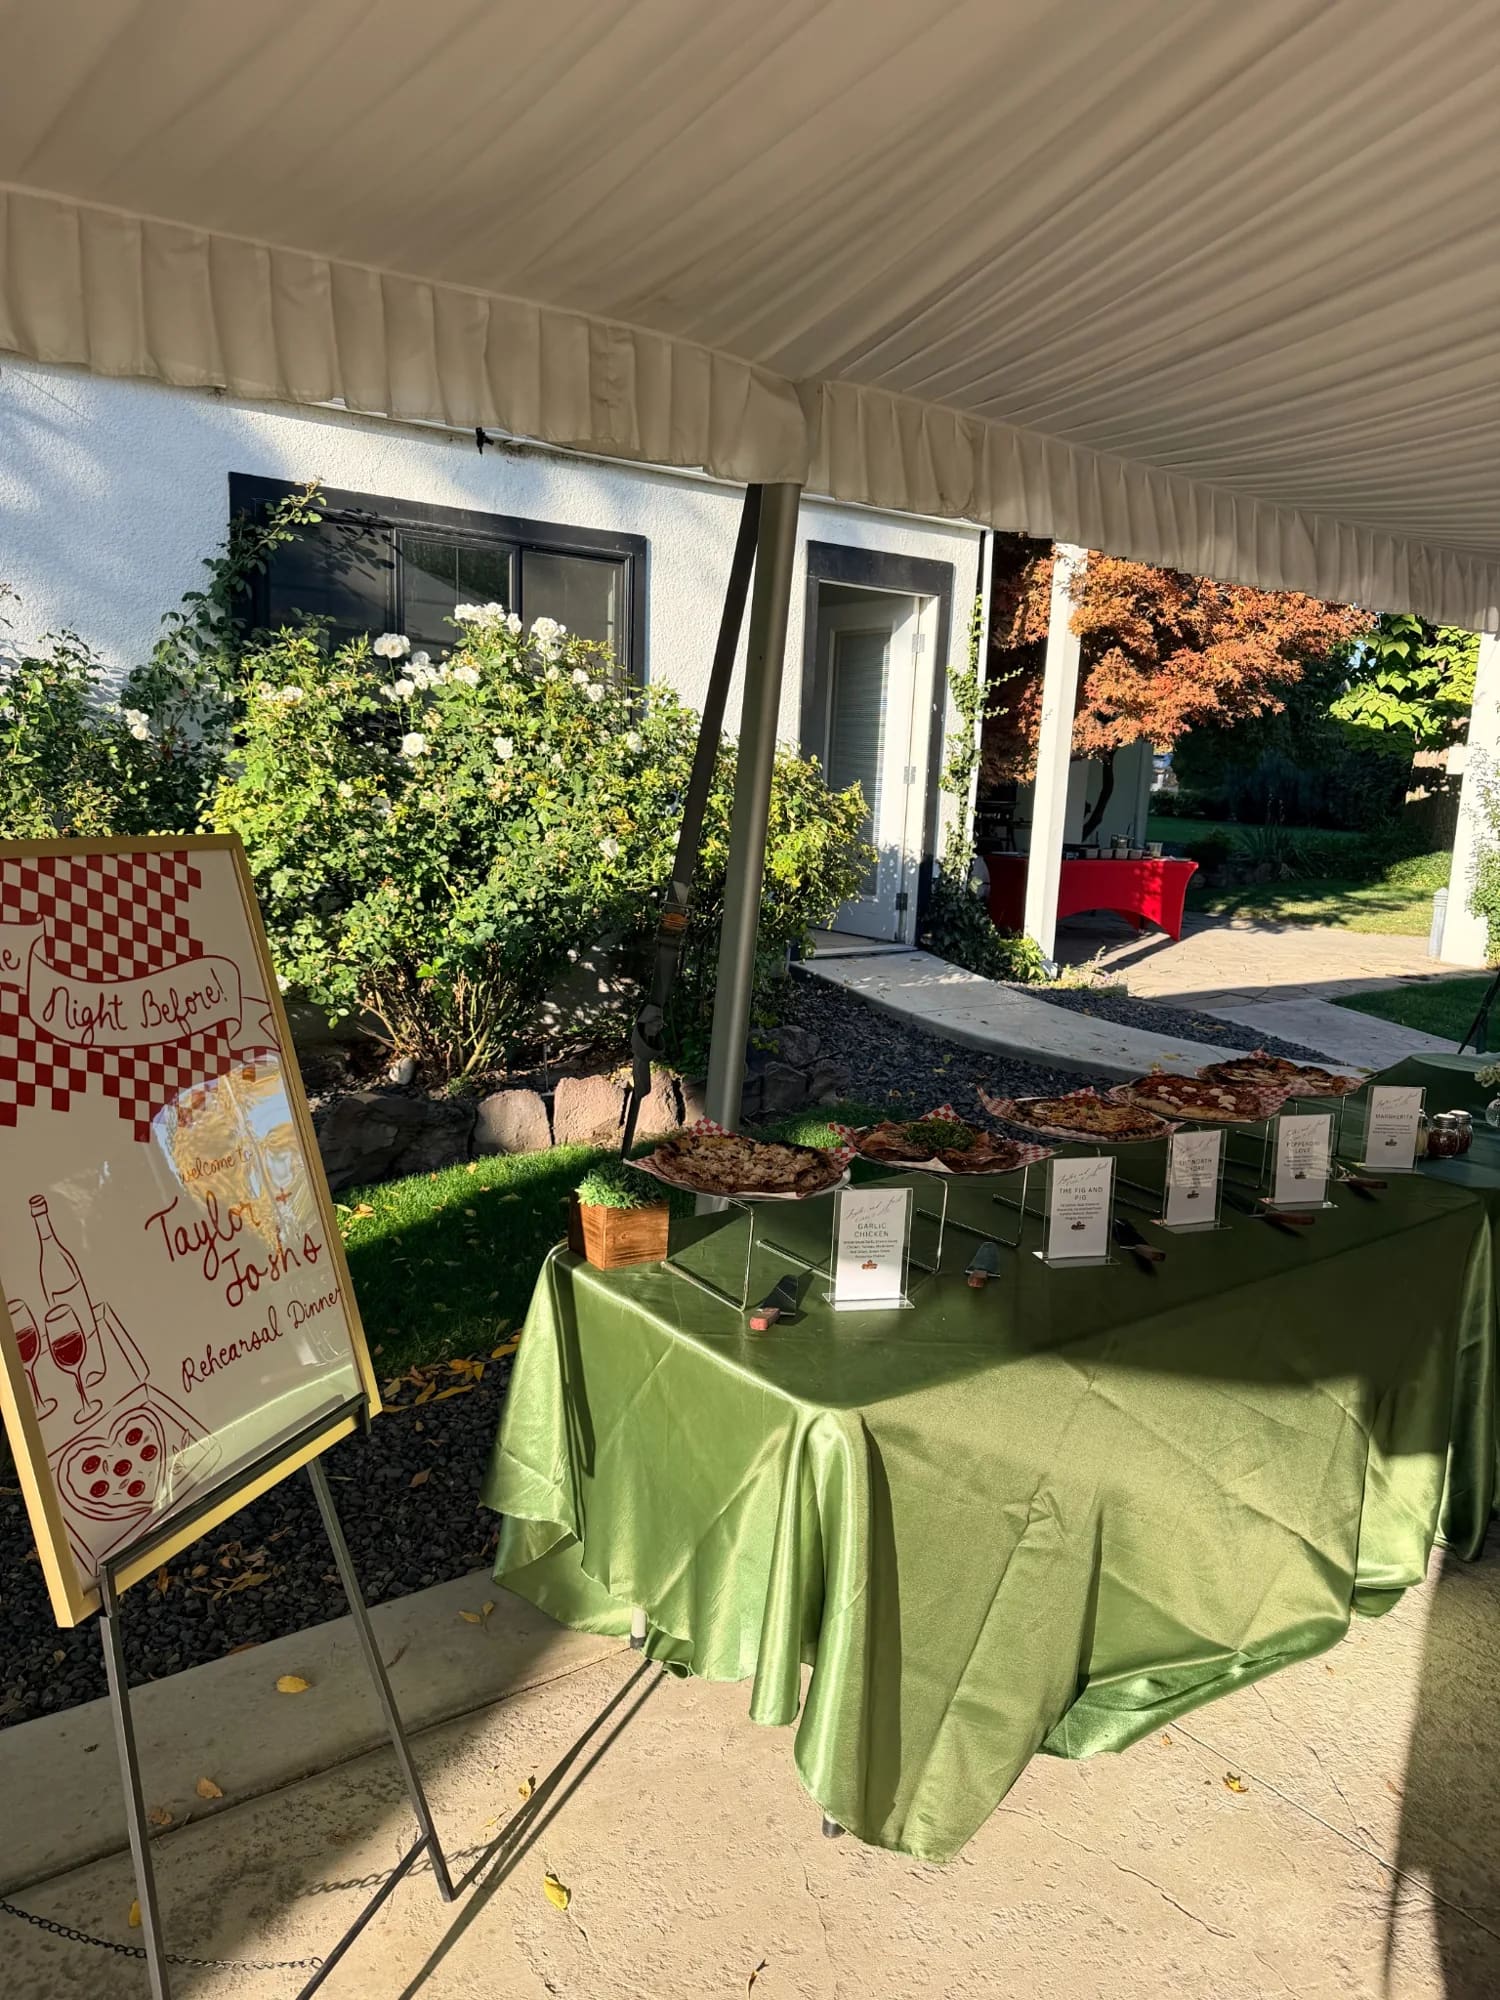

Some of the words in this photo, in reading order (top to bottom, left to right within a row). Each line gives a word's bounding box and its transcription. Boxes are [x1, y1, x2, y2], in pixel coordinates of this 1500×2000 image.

[42, 986, 128, 1049] Night
[141, 967, 228, 1036] Before!
[235, 1148, 253, 1163] to
[144, 1190, 261, 1281] Taylor
[854, 1230, 889, 1238] CHICKEN
[181, 1305, 284, 1394] Rehearsal
[287, 1288, 342, 1329] Dinner
